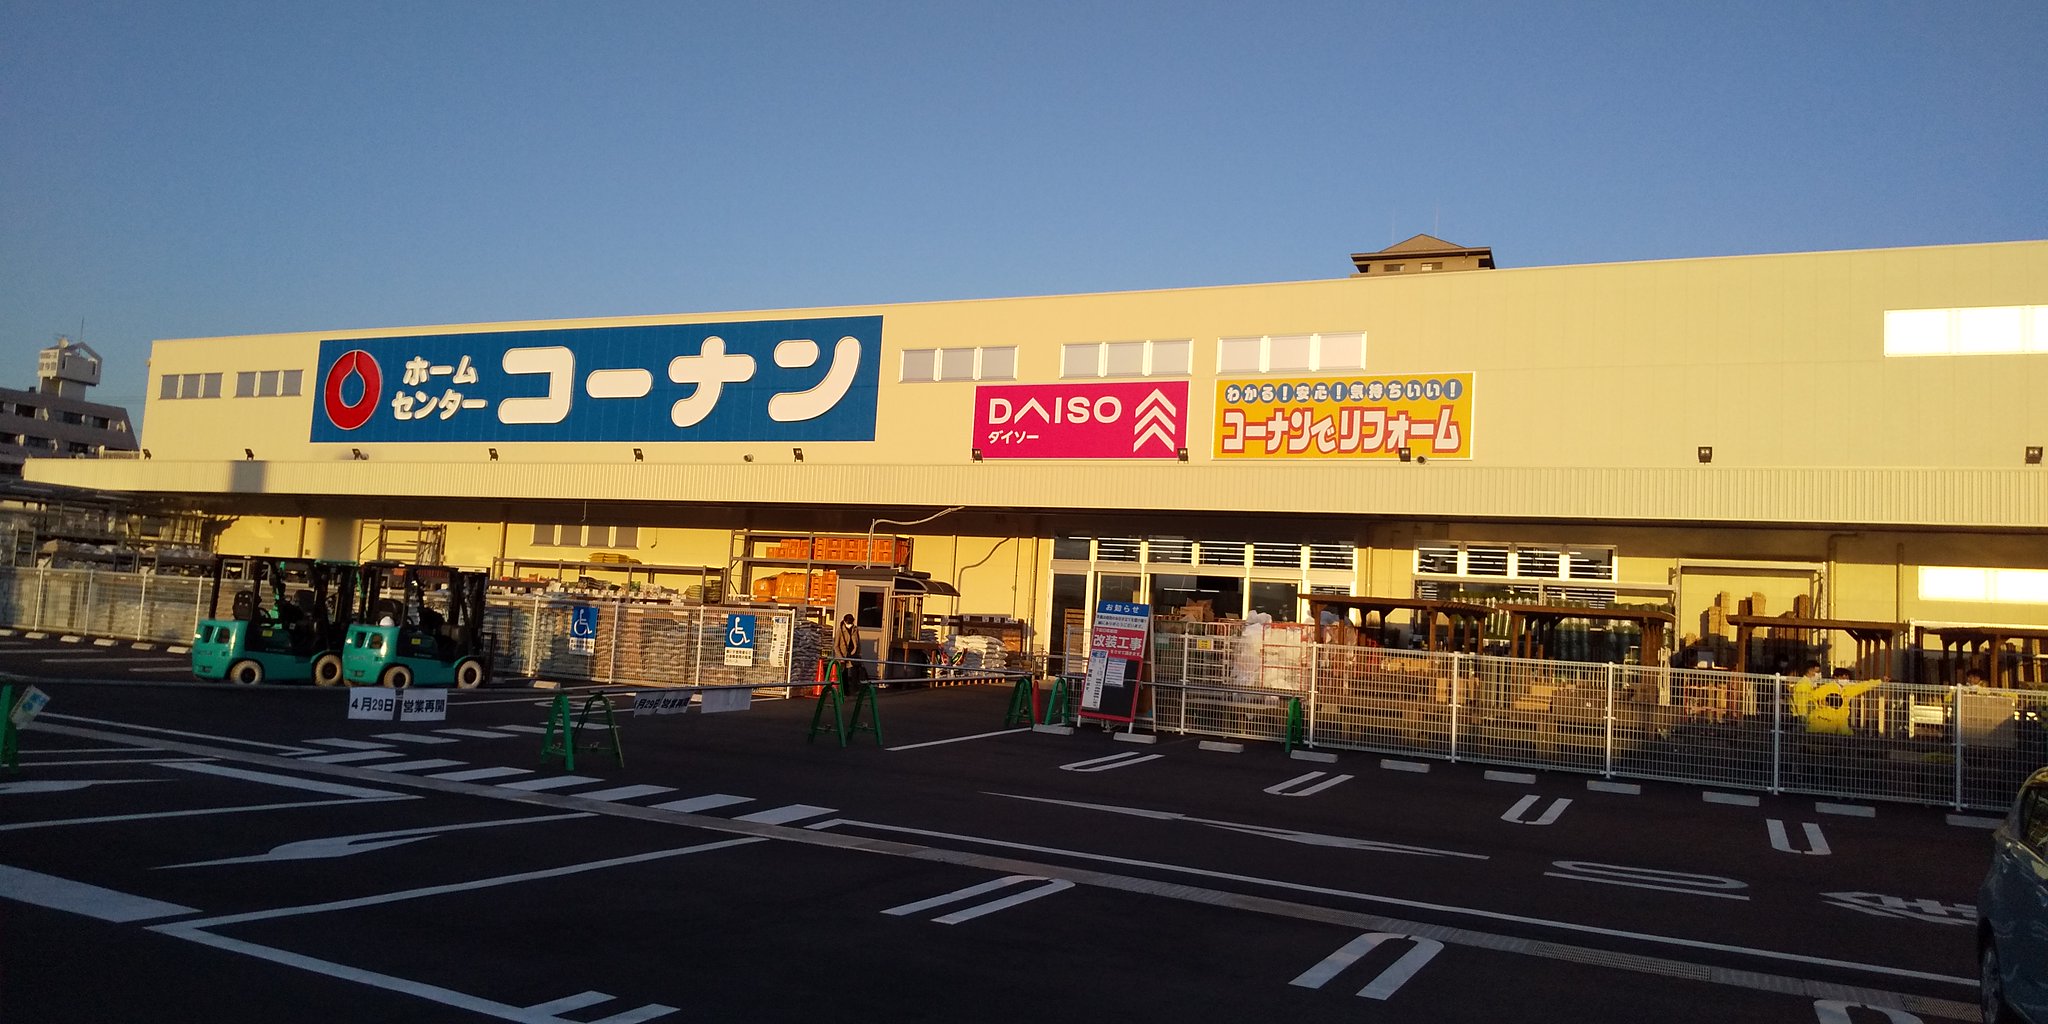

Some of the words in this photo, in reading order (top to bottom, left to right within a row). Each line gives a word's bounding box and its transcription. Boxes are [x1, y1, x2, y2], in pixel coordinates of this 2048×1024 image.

[403, 354, 479, 386] ホーム
[498, 335, 862, 428] コーナン
[391, 388, 488, 421] センター
[988, 396, 1122, 425] DAISO
[988, 430, 1039, 444] ダイソー
[1222, 405, 1461, 454] コーナンでリフォーム
[1105, 603, 1140, 614] お知らせ
[1093, 634, 1142, 651] 改装工事
[404, 699, 446, 713] 営業再開
